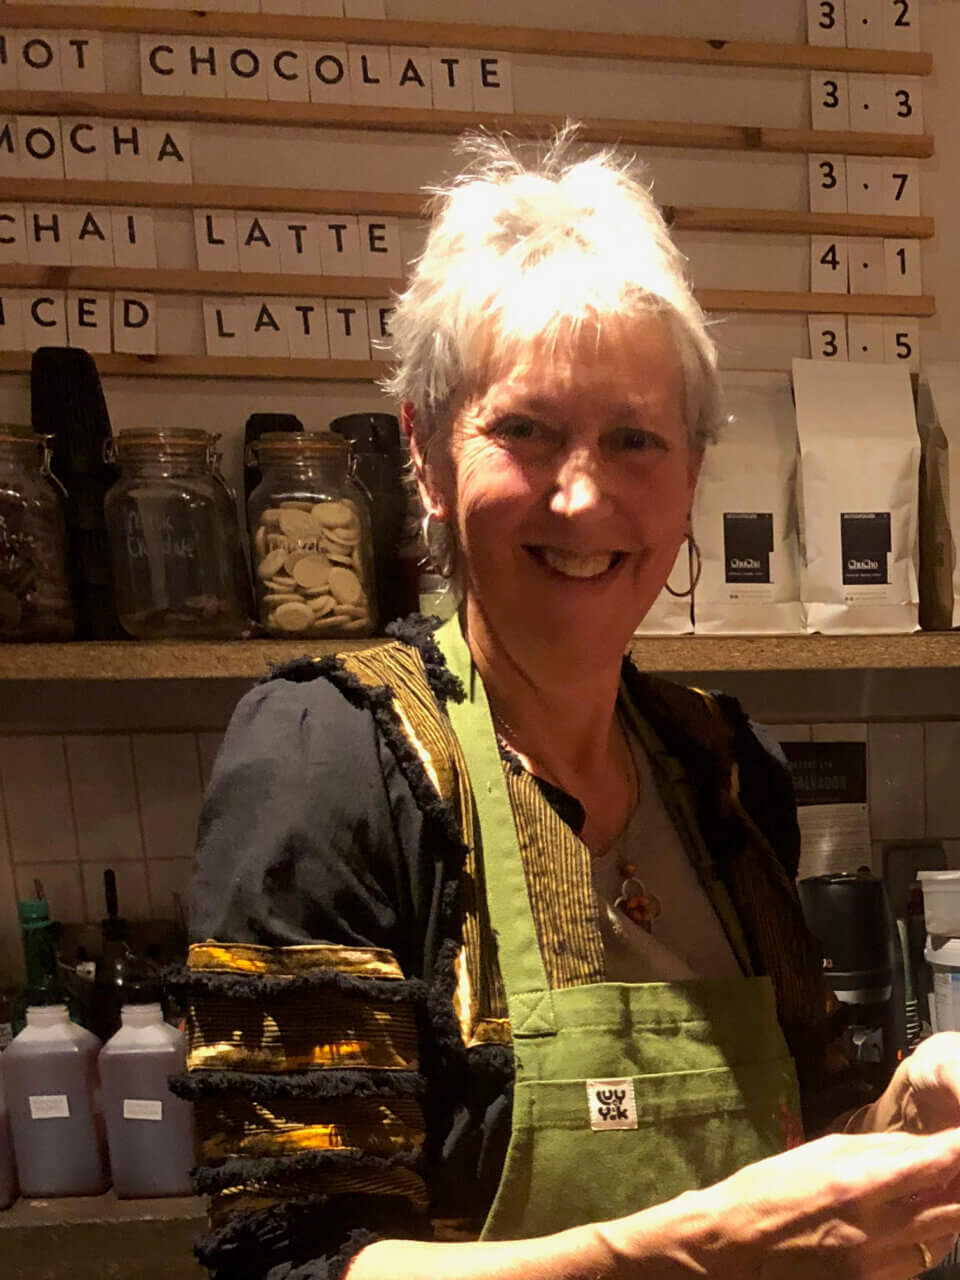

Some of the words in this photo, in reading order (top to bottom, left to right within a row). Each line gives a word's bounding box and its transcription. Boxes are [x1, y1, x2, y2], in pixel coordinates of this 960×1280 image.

[819, 0, 911, 29] 3.2
[0, 35, 89, 69] OT
[149, 44, 501, 88] CHOCOLATE
[822, 80, 913, 118] 3.3
[819, 161, 908, 201] 3.7
[0, 211, 137, 245] CHAI
[206, 214, 389, 254] LATTE
[820, 244, 907, 276] 4.1
[217, 304, 397, 338] LATTE
[822, 330, 912, 359] 3.5
